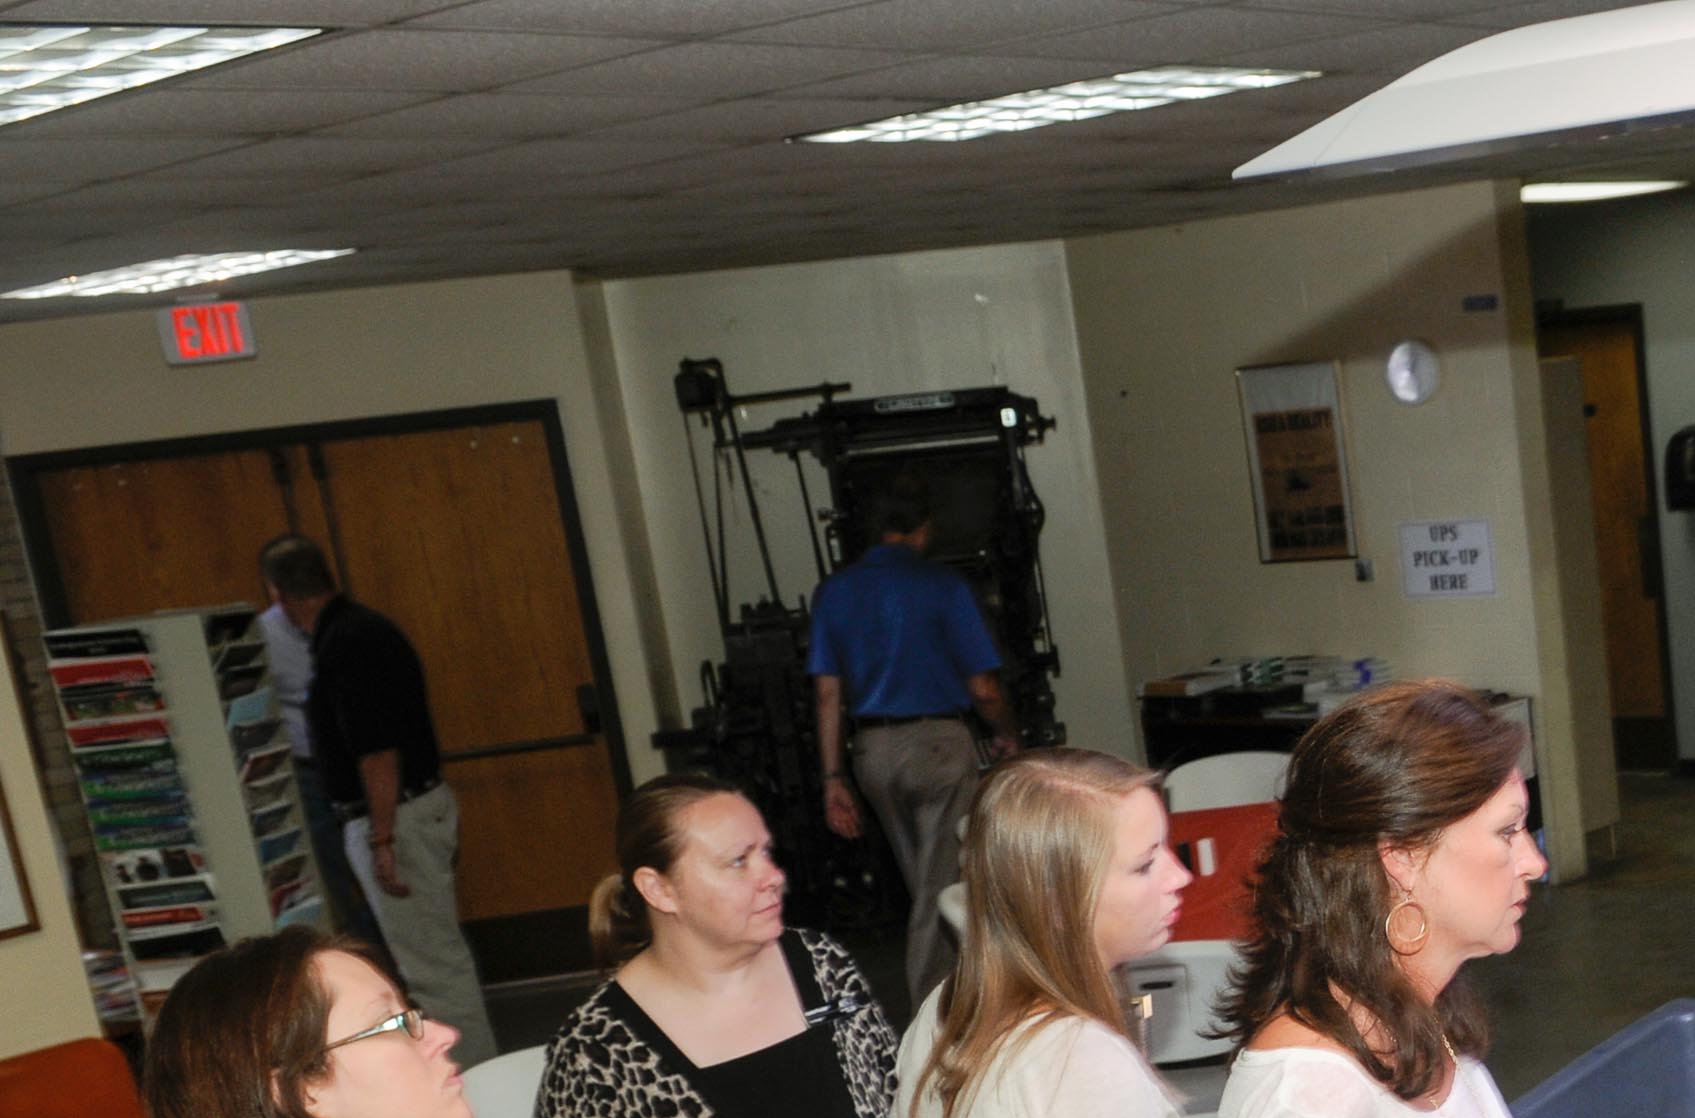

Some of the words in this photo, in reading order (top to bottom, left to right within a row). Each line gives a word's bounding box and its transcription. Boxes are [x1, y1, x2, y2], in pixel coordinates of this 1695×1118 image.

[172, 302, 244, 358] EXIT
[1429, 524, 1458, 543] UPS
[1413, 548, 1479, 569] PICK-UP
[1429, 573, 1469, 592] HERE
